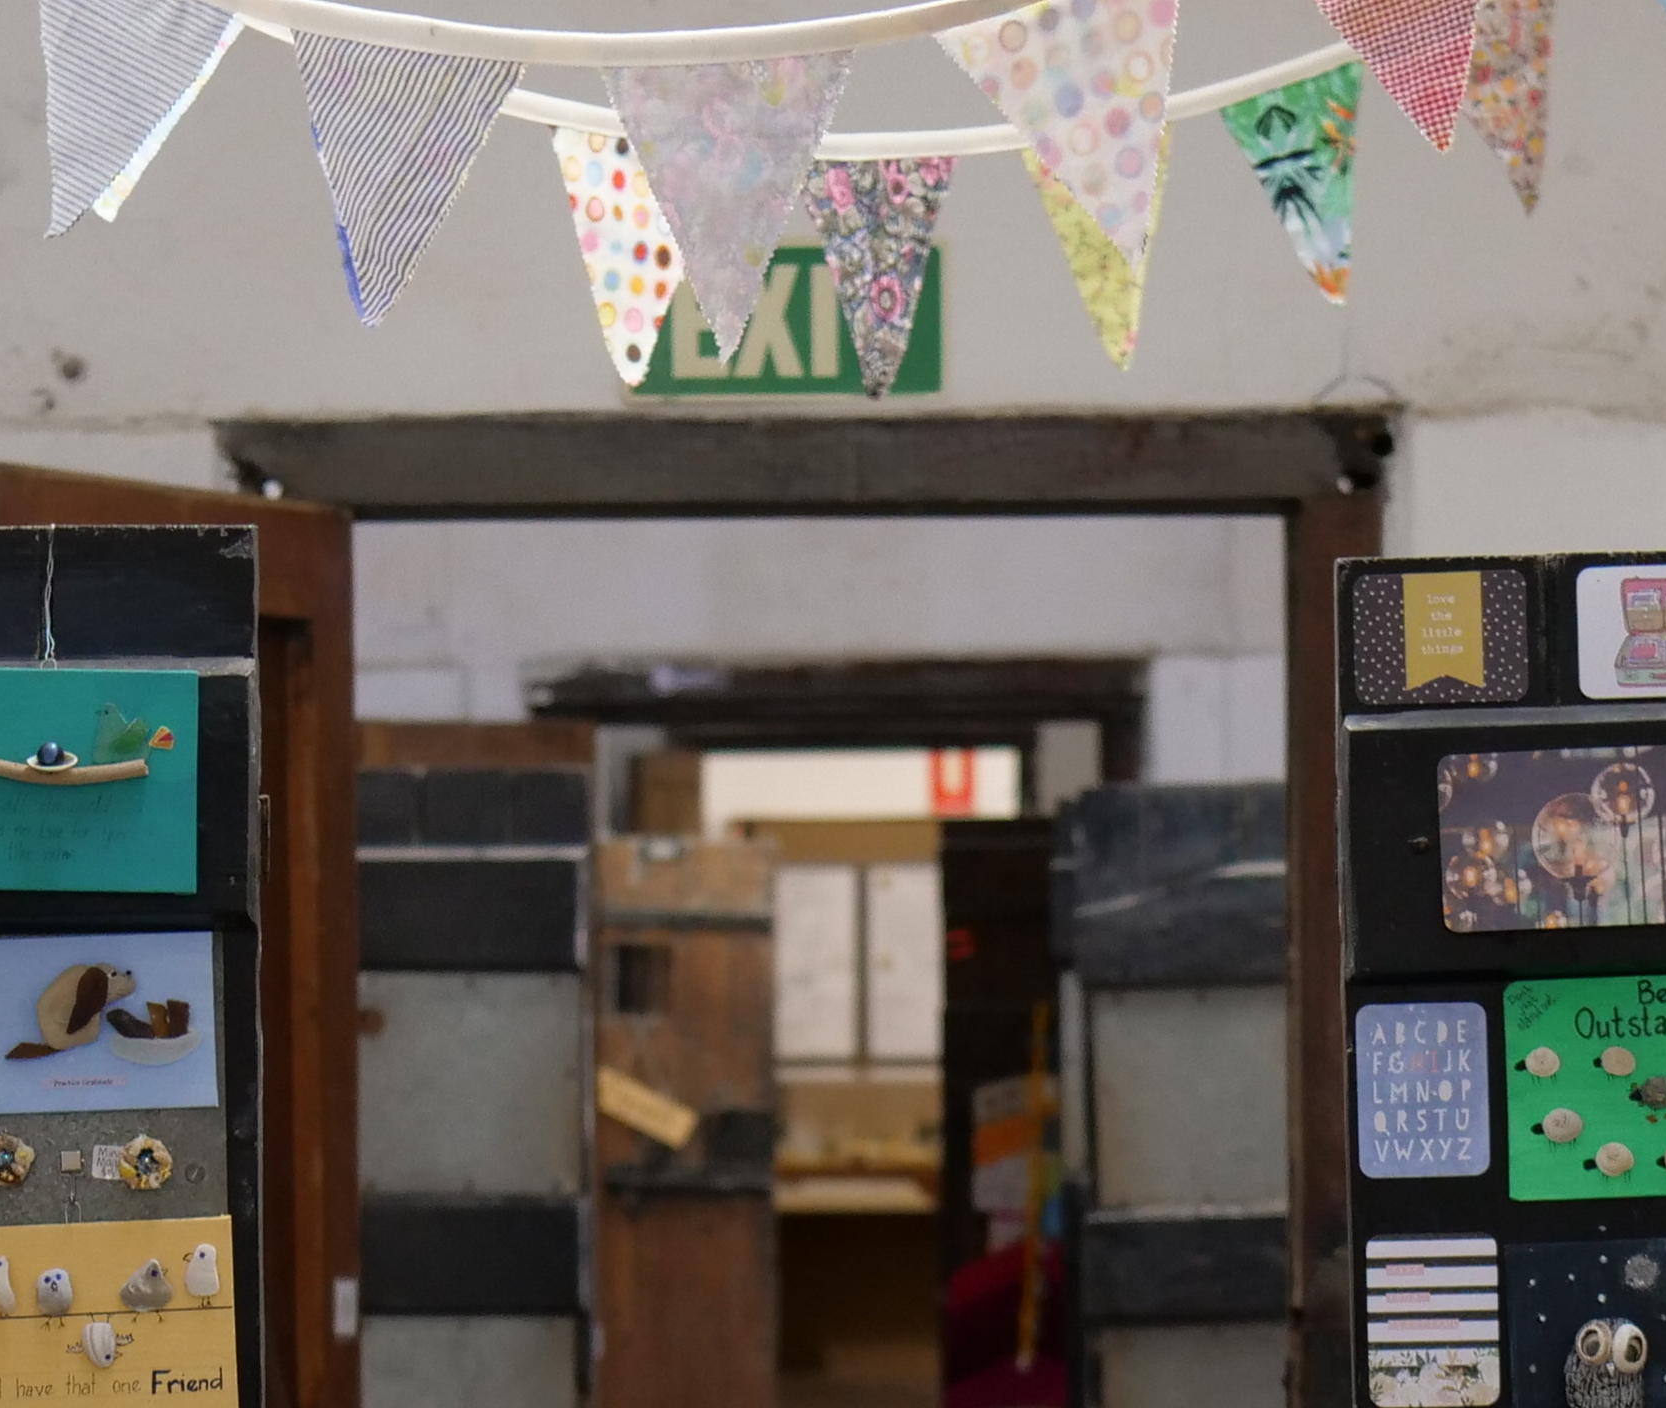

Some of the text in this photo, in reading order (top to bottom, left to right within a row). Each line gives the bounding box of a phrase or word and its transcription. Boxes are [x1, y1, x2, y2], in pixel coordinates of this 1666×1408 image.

[671, 264, 841, 378] EXI
[1431, 611, 1452, 621] the
[1422, 626, 1462, 638] little
[15, 1374, 53, 1398] have
[65, 1372, 97, 1396] that
[112, 1379, 141, 1395] one
[151, 1366, 223, 1395] Friend
